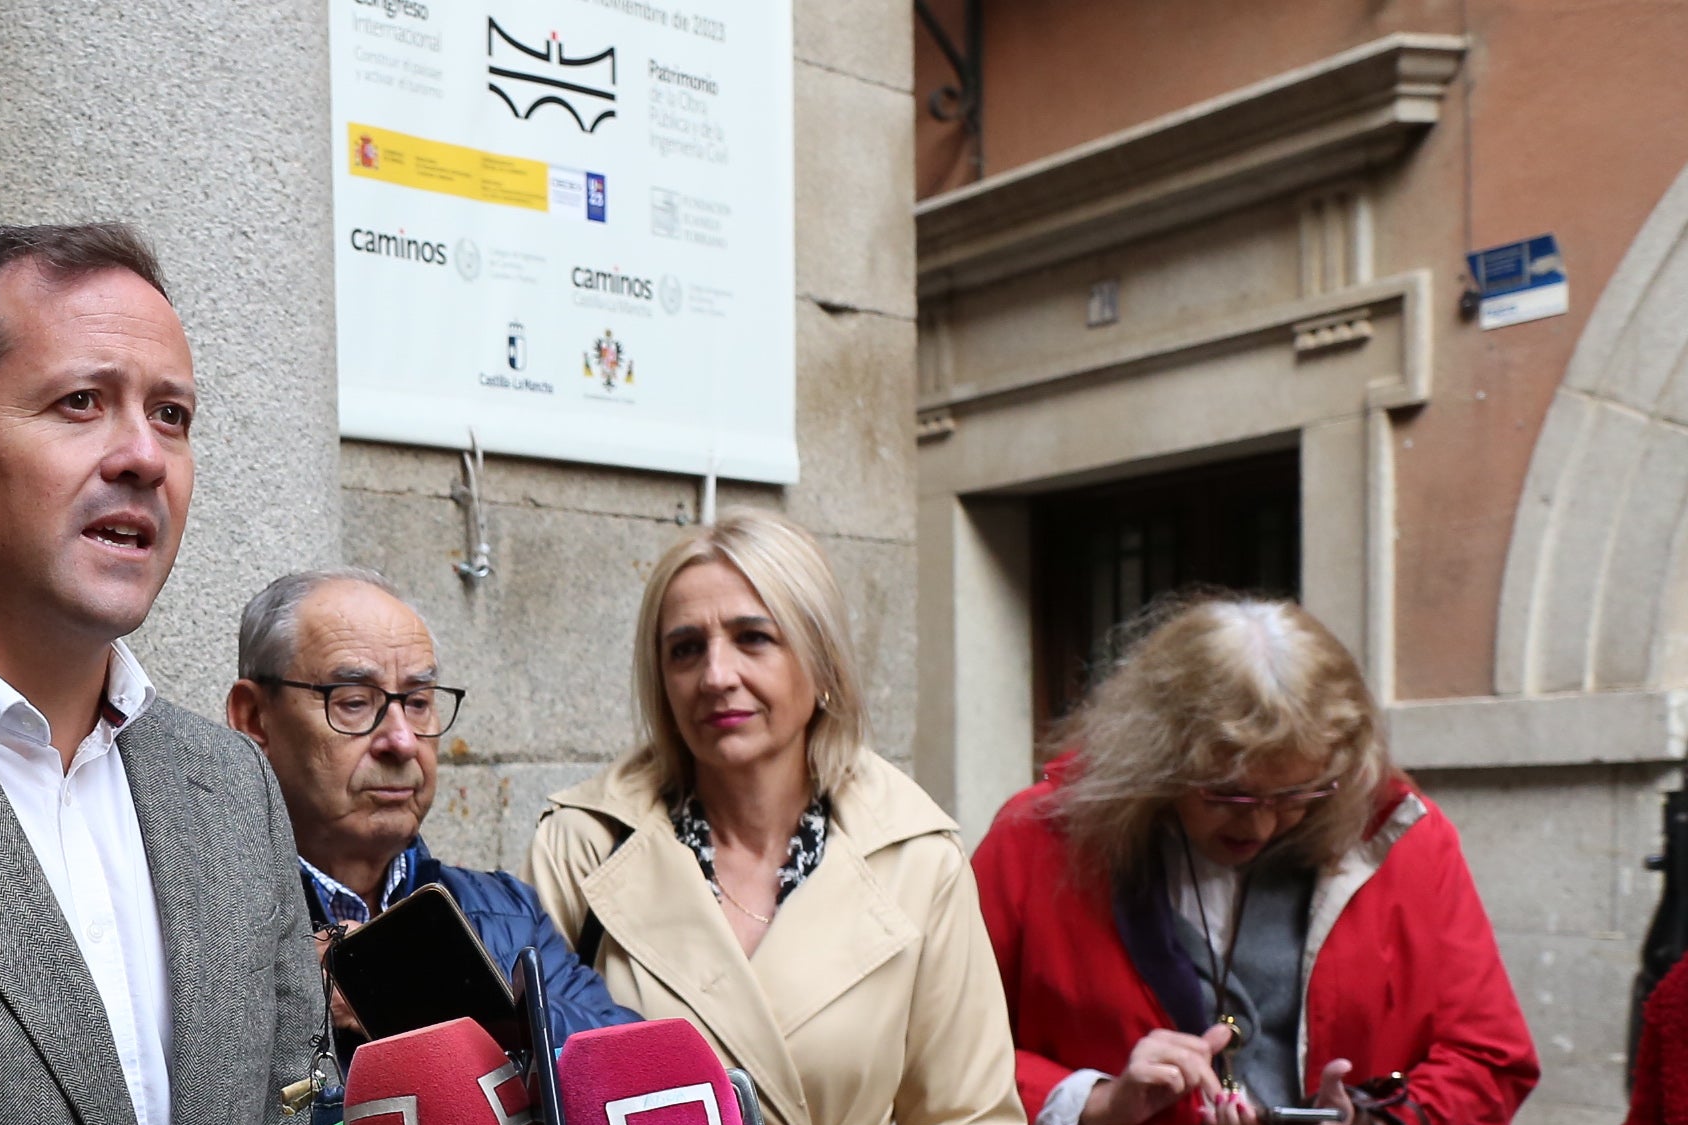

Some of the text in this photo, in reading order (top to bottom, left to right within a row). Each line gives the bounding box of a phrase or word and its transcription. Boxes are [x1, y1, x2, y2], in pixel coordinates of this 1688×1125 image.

[354, 0, 430, 21] greso
[350, 228, 447, 266] caminos
[571, 265, 653, 300] caminos
